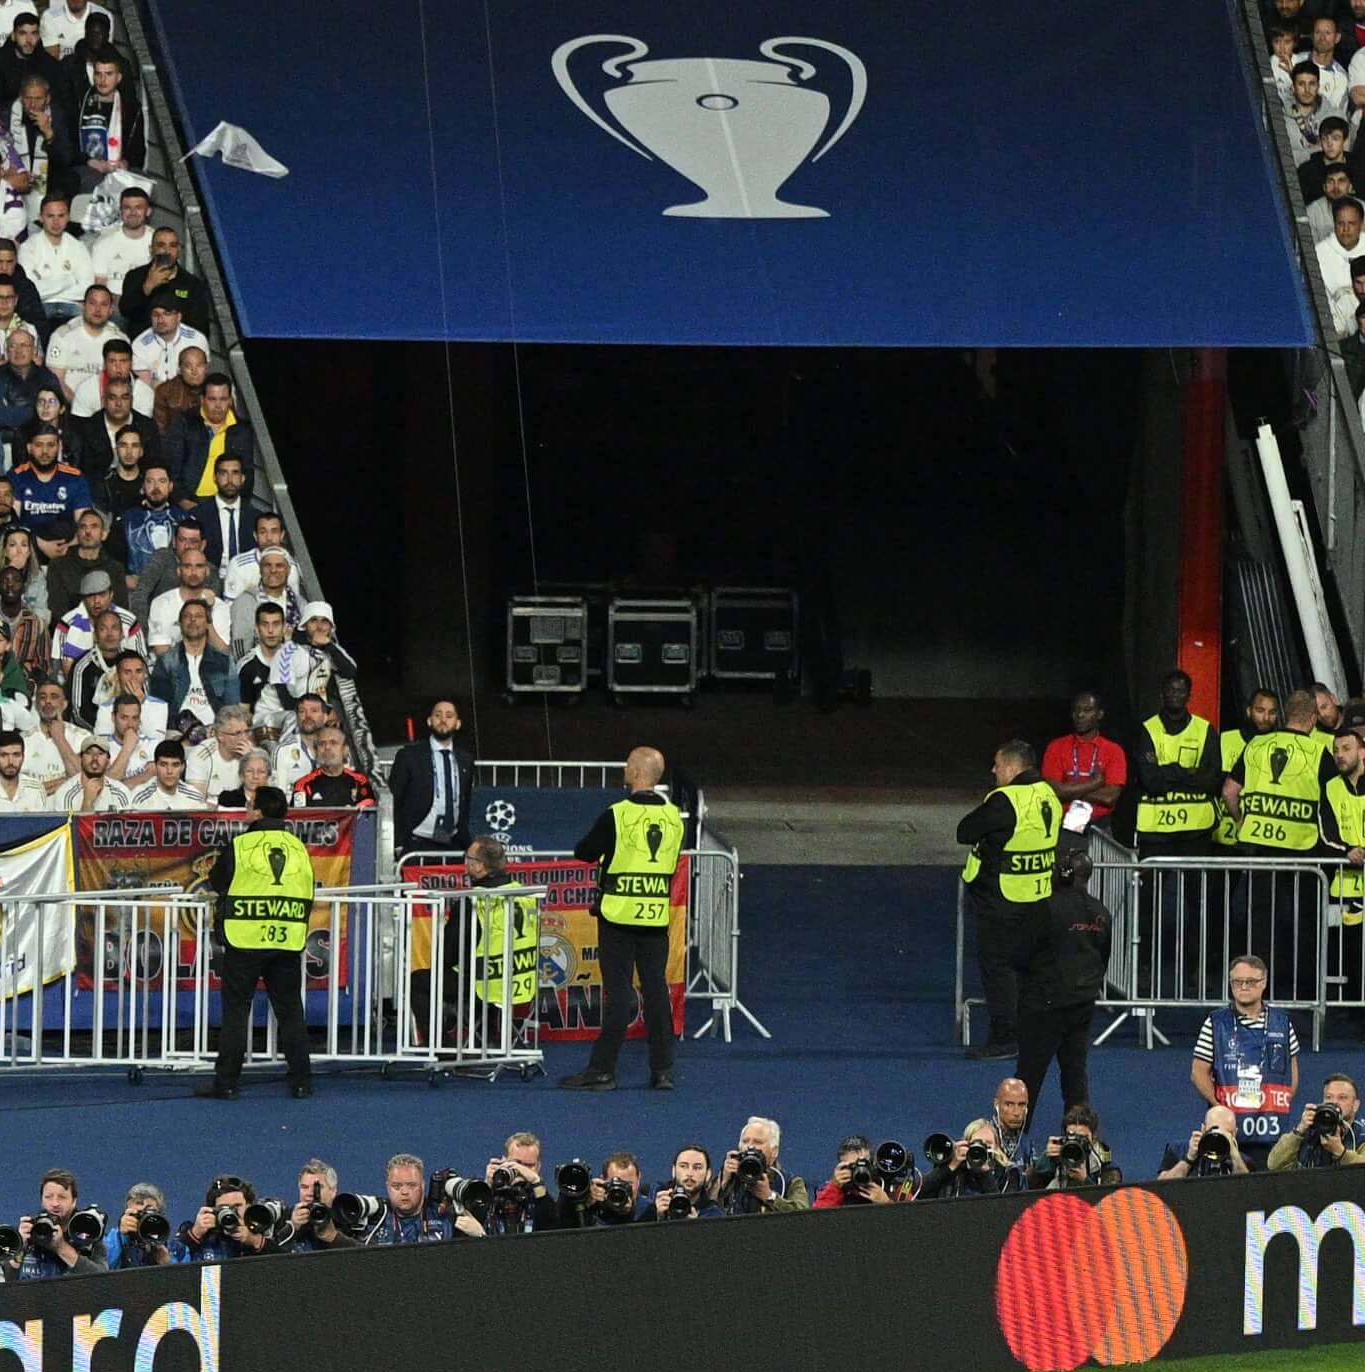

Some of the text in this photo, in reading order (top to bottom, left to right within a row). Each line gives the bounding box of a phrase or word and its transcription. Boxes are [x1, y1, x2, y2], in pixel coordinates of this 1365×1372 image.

[1157, 808, 1189, 827] 269
[92, 819, 158, 849] RAZA
[161, 818, 193, 848] DE
[1250, 821, 1287, 843] 286
[616, 877, 668, 894] STEWA
[233, 900, 306, 919] STEWARD
[634, 903, 665, 920] 257
[1242, 1117, 1281, 1137] 003
